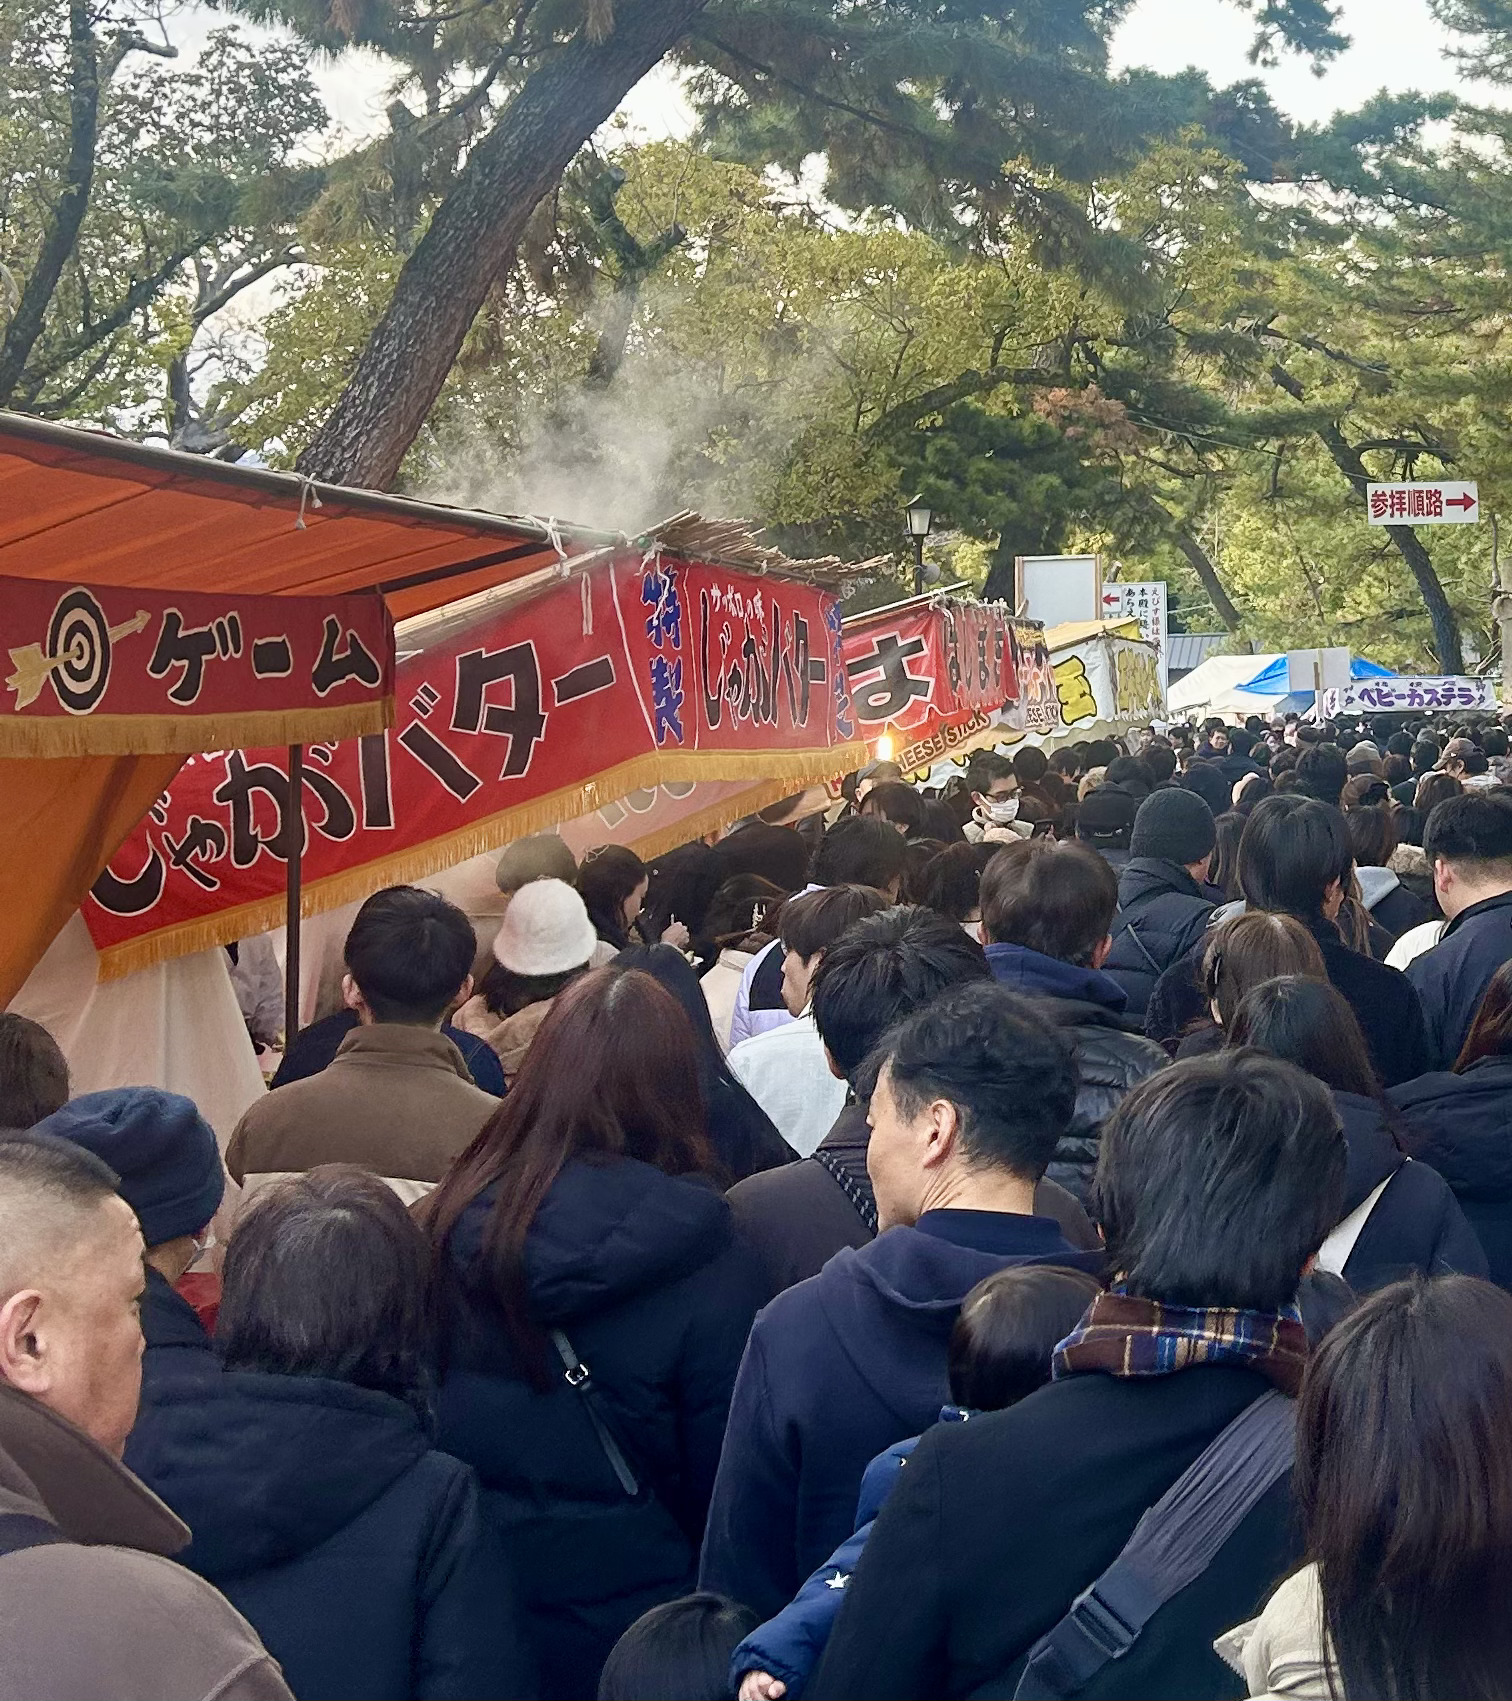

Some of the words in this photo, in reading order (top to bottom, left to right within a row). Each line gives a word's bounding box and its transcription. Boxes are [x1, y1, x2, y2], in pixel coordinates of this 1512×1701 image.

[1371, 488, 1443, 518] 参拝順路
[149, 608, 380, 705] ゲーム
[700, 588, 827, 730] じゃがバター
[1358, 687, 1476, 708] ベビーカステラ
